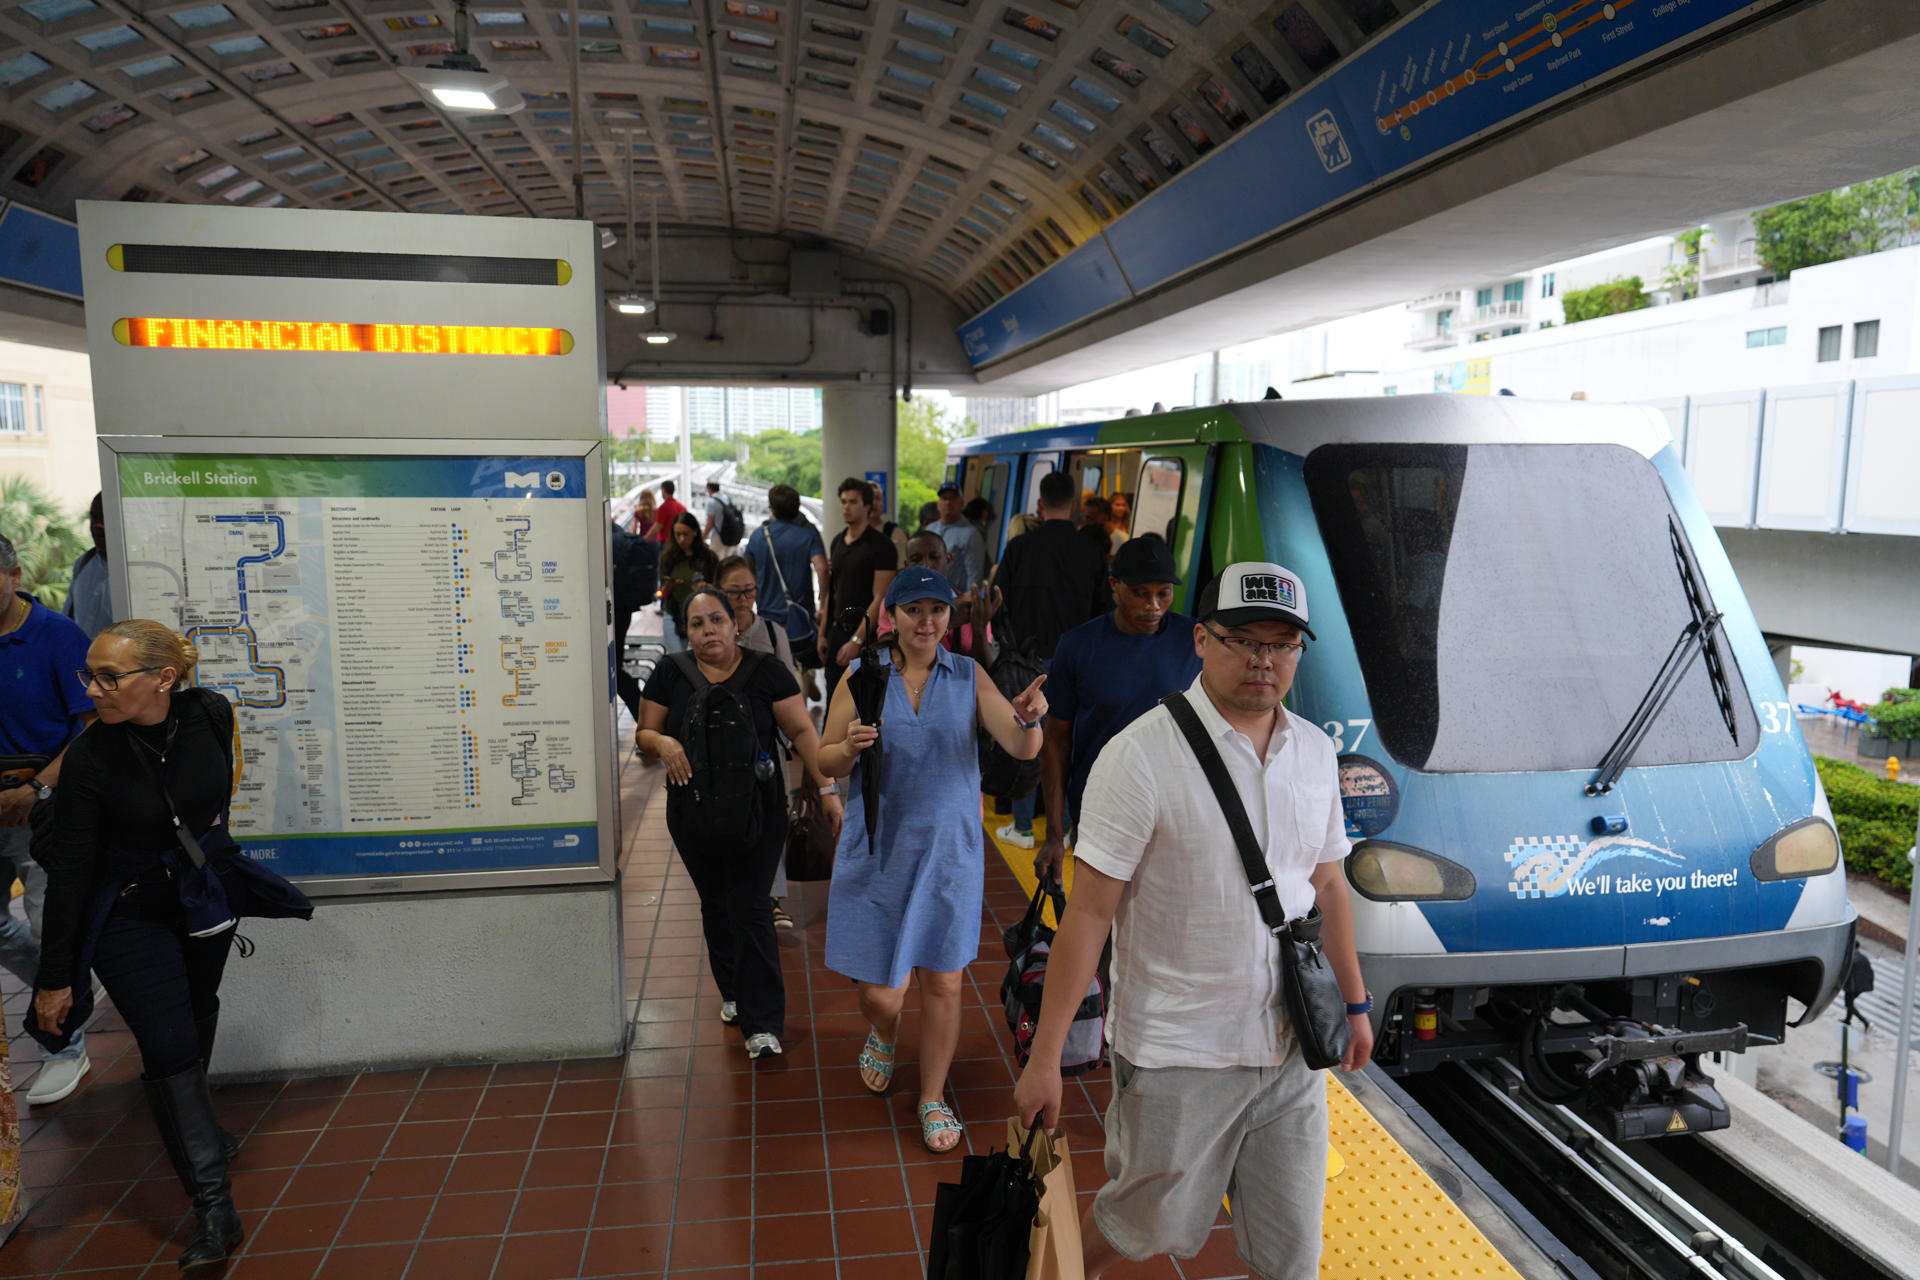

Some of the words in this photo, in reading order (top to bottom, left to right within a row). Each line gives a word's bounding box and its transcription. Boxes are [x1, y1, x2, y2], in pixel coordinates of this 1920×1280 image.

[1601, 31, 1616, 44] First
[1615, 21, 1635, 36] Street
[147, 316, 360, 351] FINANCIAL
[373, 322, 554, 356] DISTRICT
[144, 471, 200, 485] Brickell
[205, 471, 258, 485] Station
[1245, 576, 1277, 590] WE
[1245, 588, 1278, 600] ARE
[1759, 701, 1791, 734] 37
[1323, 718, 1372, 753] 37
[1566, 874, 1611, 896] We'll
[1616, 873, 1652, 894] take
[1656, 875, 1687, 897] you
[1690, 868, 1738, 889] there!
